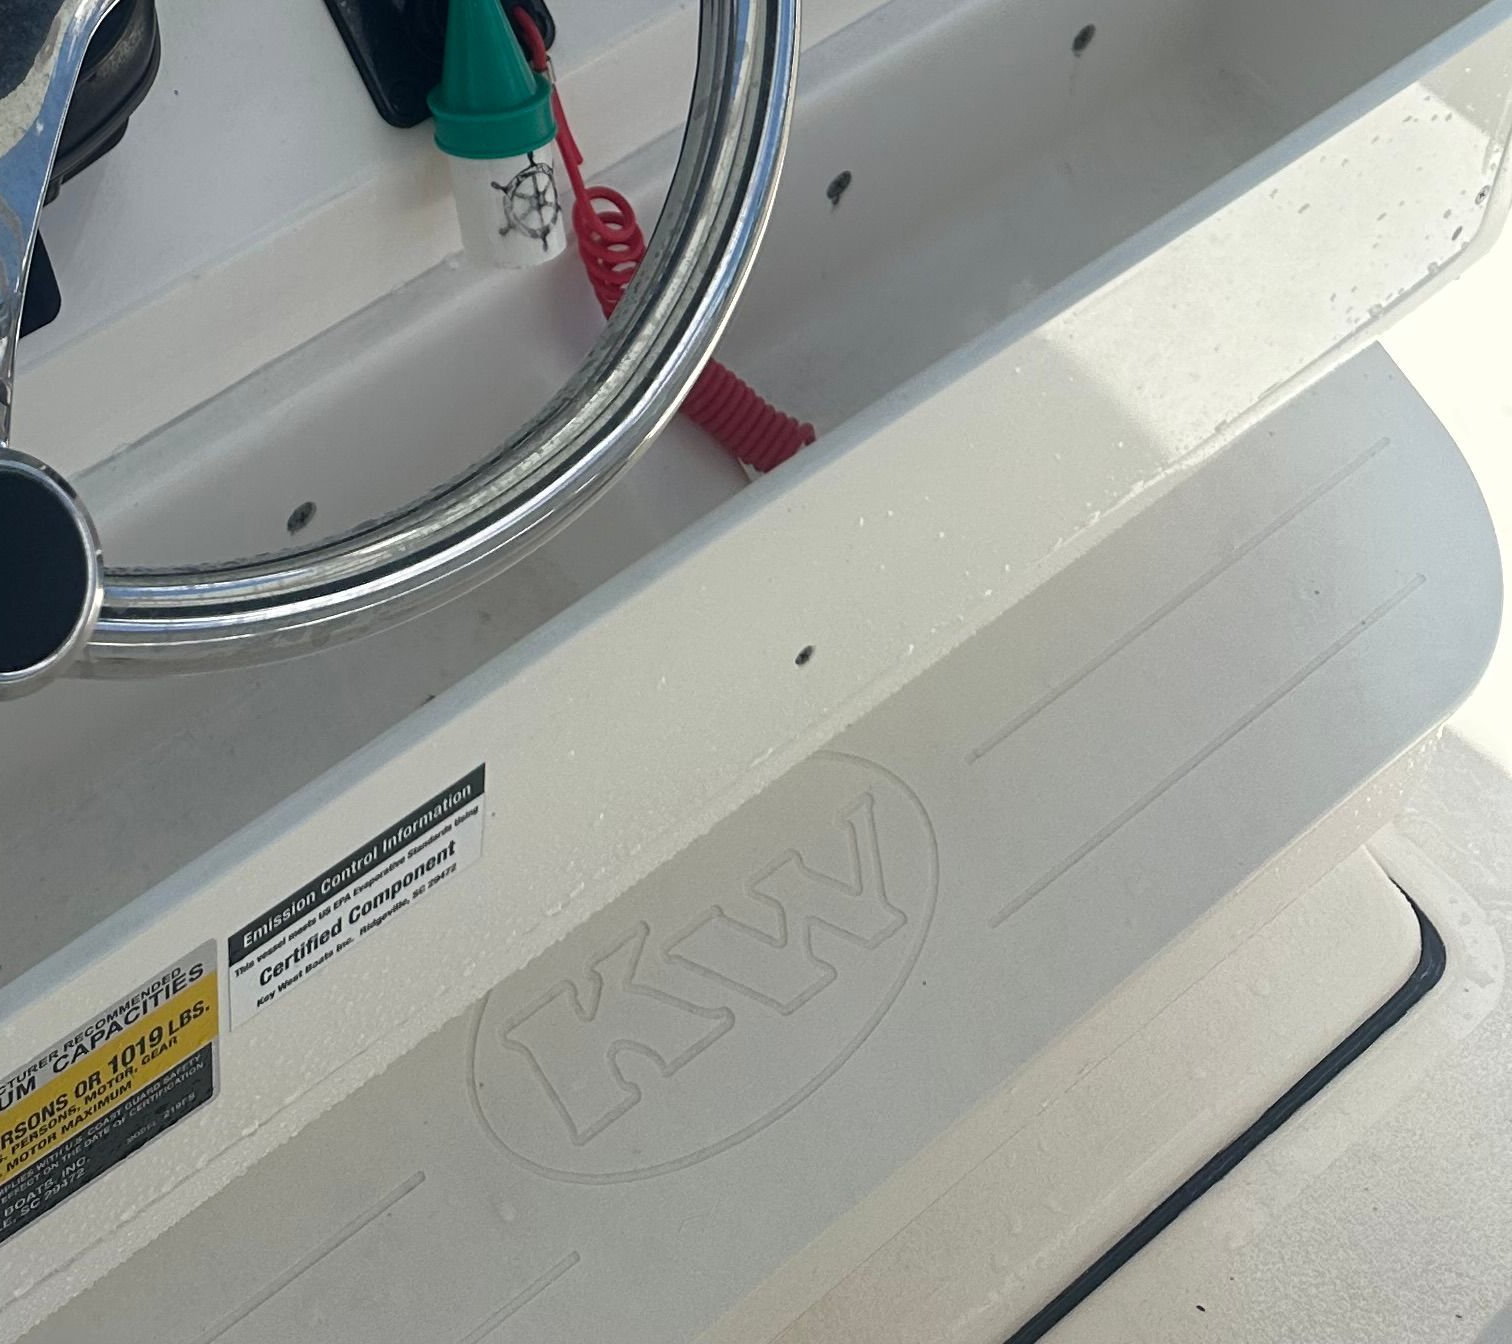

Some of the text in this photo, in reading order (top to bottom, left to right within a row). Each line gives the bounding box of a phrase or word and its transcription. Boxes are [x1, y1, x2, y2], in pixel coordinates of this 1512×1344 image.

[243, 784, 471, 948] Emission Control Information
[259, 839, 455, 986] Certified Component
[52, 962, 203, 1073] CAPACITIES
[63, 966, 180, 1052] RECOMMENDED
[500, 793, 907, 1146] KW
[74, 1070, 101, 1099] OR
[107, 1025, 163, 1075] 1019
[168, 999, 209, 1036] LBS.
[141, 1035, 177, 1065] GEAR
[6, 1131, 56, 1172] MOTOR
[61, 1079, 131, 1135] MAXIMUM
[20, 1197, 40, 1216] SC
